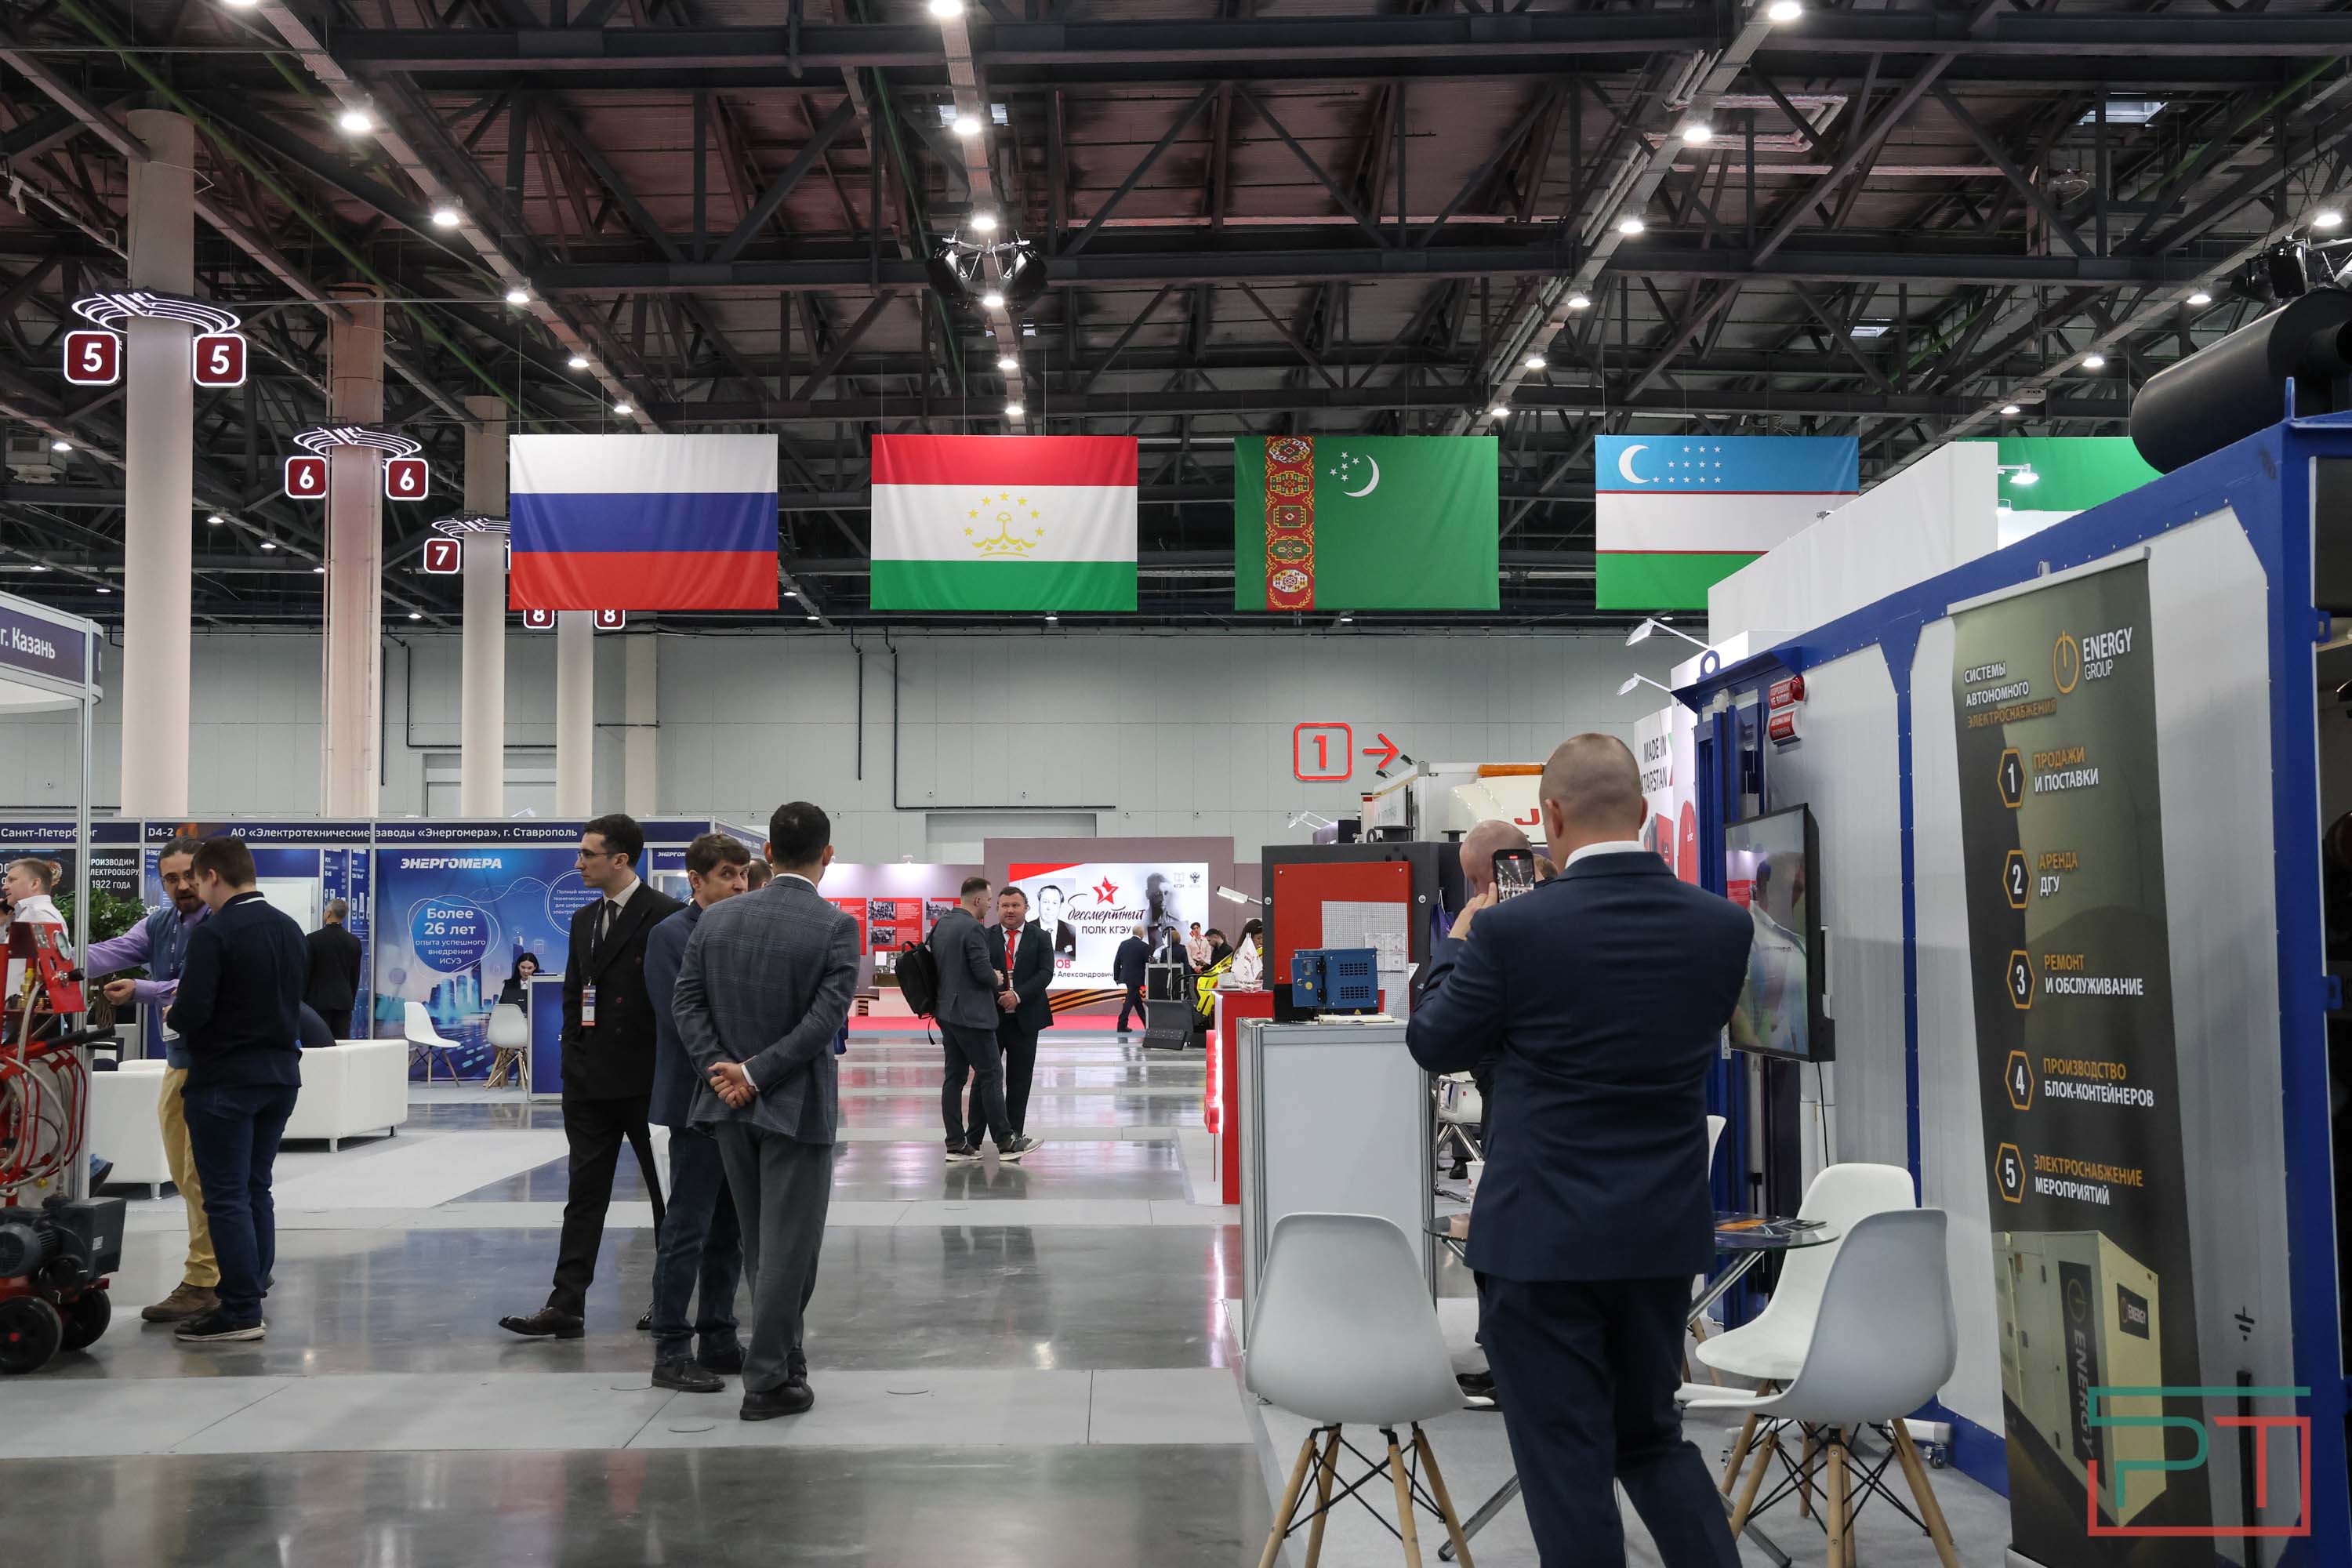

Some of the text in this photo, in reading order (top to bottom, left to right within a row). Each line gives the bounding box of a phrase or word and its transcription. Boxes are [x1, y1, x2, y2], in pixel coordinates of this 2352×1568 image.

[82, 342, 102, 372] 5
[210, 344, 230, 375] 5
[299, 465, 314, 489] 6
[399, 467, 416, 491] 6
[435, 546, 449, 566] 7
[12, 626, 56, 659] Казань
[2082, 626, 2132, 662] ENERGY
[1964, 662, 2006, 684] СИСТЕМЫ
[2084, 660, 2113, 681] GROUP
[1965, 681, 2029, 707] АВТОНОМНОГО
[1967, 698, 2057, 728] ЭЛЕКТРОСНАБЖЕНИЯ
[1312, 735, 1327, 769] 1
[1643, 733, 1667, 764] MADE IN
[2033, 746, 2085, 771] ПРОДАЖИ
[2007, 763, 2016, 793] 1
[2034, 768, 2099, 793] И ПОСТАВКИ
[1, 828, 98, 839] Санкт-Петербг
[148, 827, 175, 837] D4-2
[230, 828, 246, 837] АО
[249, 827, 371, 839] «Электротехнические
[376, 829, 415, 839] заводы
[418, 828, 501, 839] «Энергомера»,
[514, 828, 578, 839] Ставрополь
[401, 858, 503, 869] ЭНЕРГОМЕРА
[2038, 851, 2078, 870] АРЕНДА
[89, 869, 140, 877] ЛЕКТРООБОРУ
[92, 880, 131, 890] 1922 ГОДА
[2013, 864, 2023, 895] 2
[2040, 874, 2060, 897] ДГУ
[426, 908, 474, 919] Более
[424, 921, 477, 935] 26 лет
[1081, 926, 1131, 935] ПОЛК КГЭУ
[441, 939, 486, 948] успешного
[2044, 953, 2084, 971] РЕМОНТ
[2016, 964, 2025, 995] 3
[2045, 977, 2143, 996] И ОБСЛУЖИВАНИЕ
[2016, 1065, 2024, 1095] 4
[2043, 1057, 2126, 1081] ПРОИЗВОДСТВО
[2044, 1080, 2154, 1107] БЛОК-КОНТЕЙНЕРОВ
[2005, 1158, 2016, 1189] 5
[2034, 1153, 2143, 1187] ЭЛЕКТРОСНАБЖЕНИЕ
[2035, 1176, 2110, 1206] МЕРОПРИЯТИЙ
[2128, 1304, 2147, 1324] ENERGY
[2074, 1329, 2096, 1458] ENERGY
